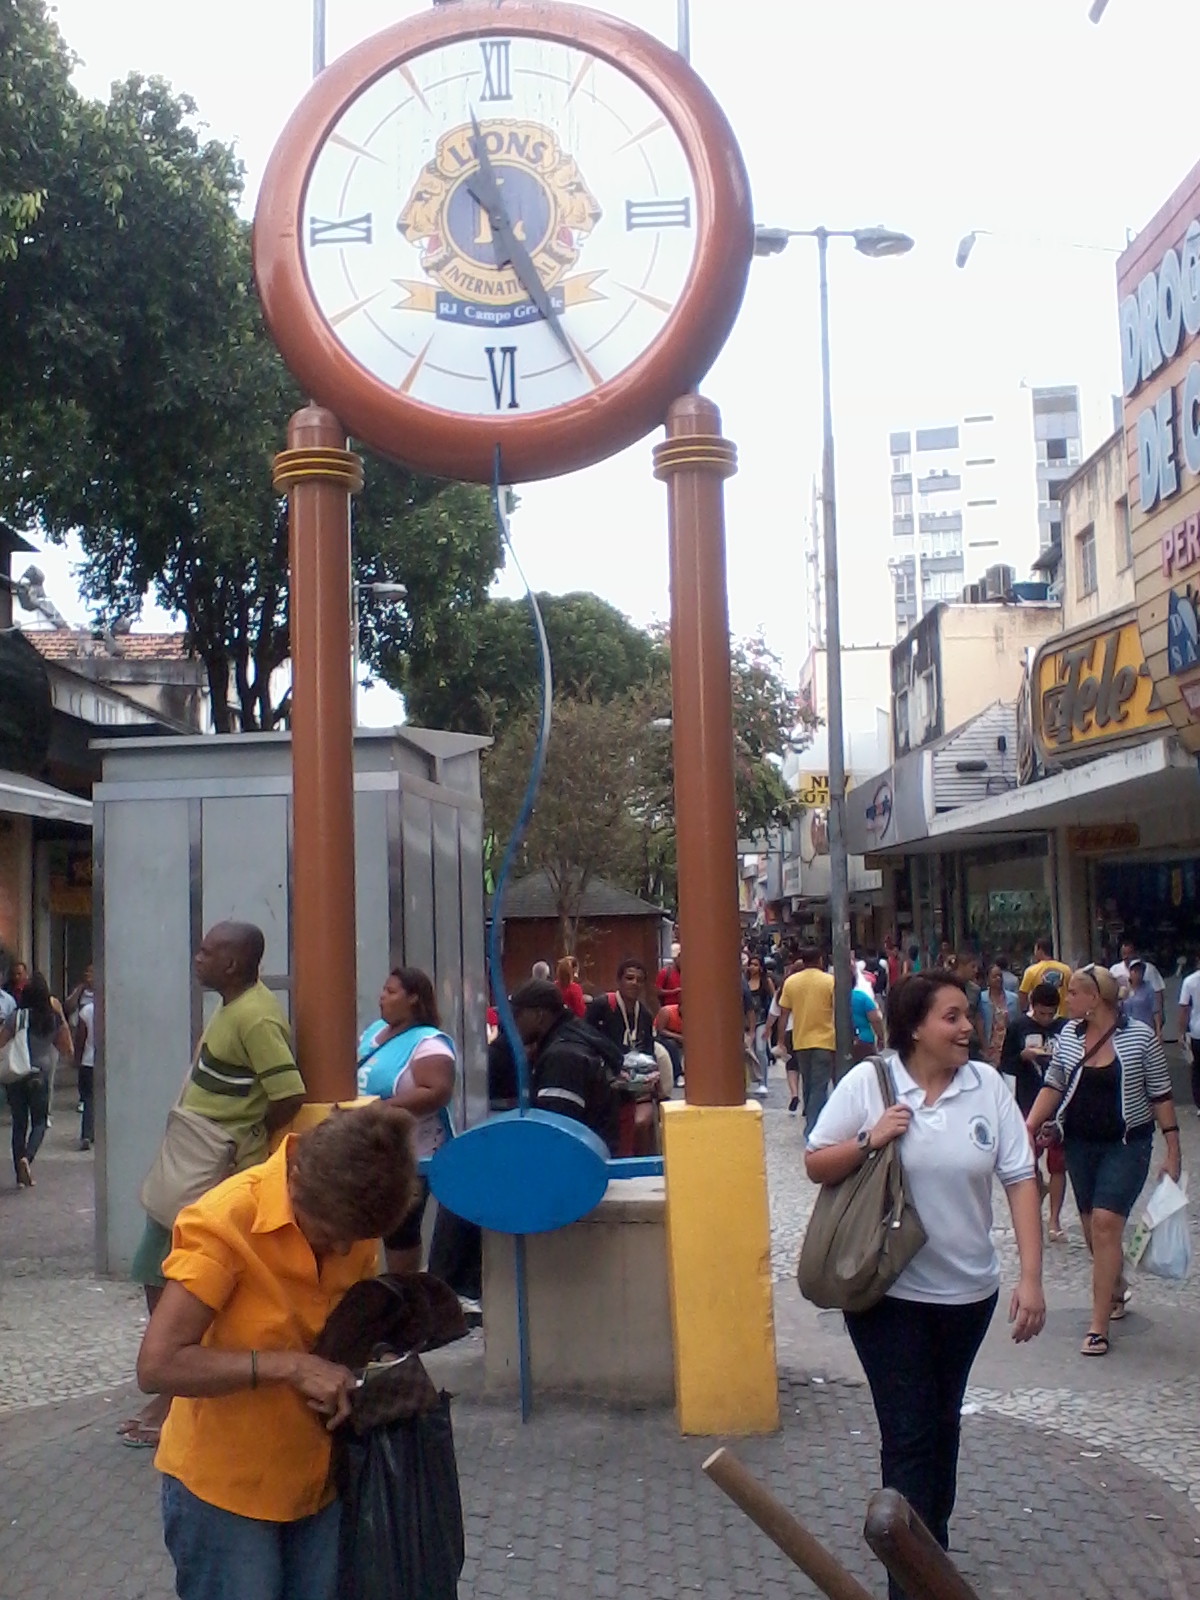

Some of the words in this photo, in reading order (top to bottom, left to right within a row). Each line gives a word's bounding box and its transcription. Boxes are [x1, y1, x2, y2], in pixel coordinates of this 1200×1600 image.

[479, 41, 512, 101] XII
[447, 131, 549, 168] LIONS
[625, 197, 691, 231] III
[445, 261, 556, 296] INTERNATIAL
[464, 306, 511, 324] Campo
[514, 297, 563, 318] Grae
[485, 346, 517, 409] VI
[1138, 388, 1177, 512] DE
[1056, 631, 1138, 745] Tele
